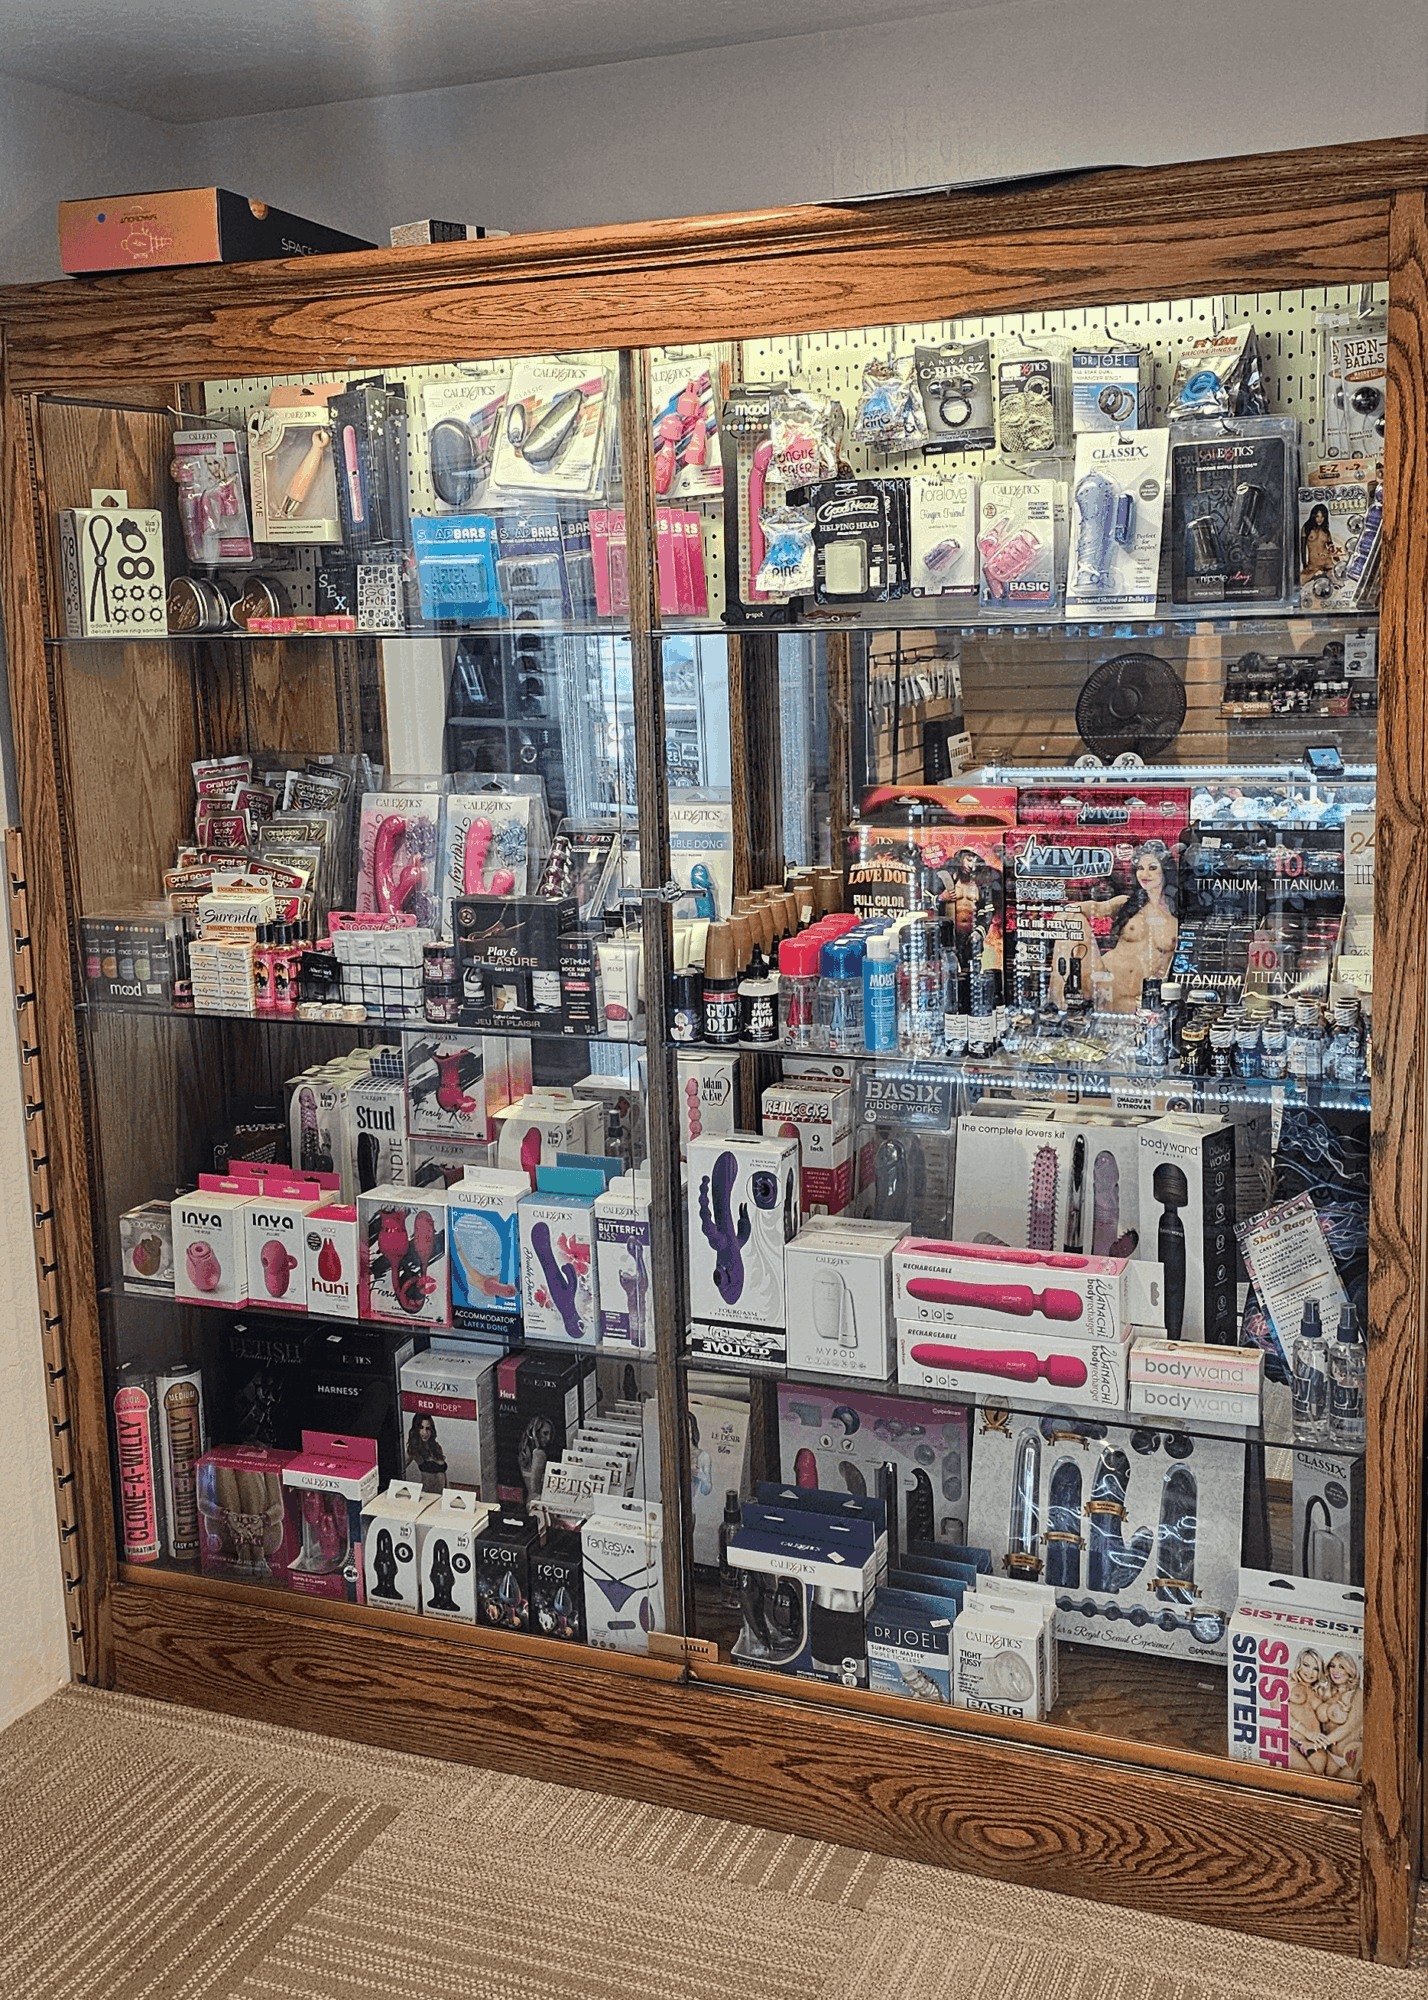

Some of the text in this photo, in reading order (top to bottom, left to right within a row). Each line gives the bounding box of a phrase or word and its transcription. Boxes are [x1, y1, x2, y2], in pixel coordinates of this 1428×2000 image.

[1345, 353, 1385, 369] BALLS
[533, 367, 587, 381] CALEXOTICS
[920, 362, 987, 379] C-RINGZ
[735, 403, 769, 417] mood
[1092, 445, 1149, 460] CLASSIX
[925, 487, 968, 501] oralove
[819, 521, 880, 533] HELPING HEAD
[1136, 532, 1156, 541] Perfect
[1200, 573, 1229, 586] nipple
[1009, 582, 1050, 592] BASIC
[376, 798, 422, 811] CALEXOTICS
[1086, 808, 1129, 819] VIVID
[694, 840, 723, 850] DONG
[1032, 847, 1111, 865] VIVID
[848, 869, 882, 885] LOVE
[1073, 863, 1111, 877] RAW
[1016, 880, 1065, 890] STANDING
[1194, 878, 1258, 890] TITANIUM
[1271, 878, 1336, 891] TITANIUM
[853, 894, 905, 908] FULL COLOR
[202, 905, 258, 924] Surenda
[1017, 916, 1029, 928] LET
[487, 946, 519, 958] Play &
[473, 955, 539, 967] PLEASURE
[559, 957, 591, 966] OPTIMUM
[1172, 953, 1199, 974] 5K
[869, 973, 895, 987] MOIST
[1171, 972, 1242, 987] TITANIUM
[110, 982, 142, 997] mood
[705, 1003, 738, 1018] GUN
[751, 1009, 774, 1017] SAUCE
[753, 1002, 771, 1010] FUCK
[475, 1018, 492, 1026] JEU
[506, 1019, 541, 1028] PLAISIR
[706, 1018, 738, 1033] OIL
[701, 1076, 722, 1091] Adam
[701, 1091, 722, 1102] & Eve
[865, 1080, 943, 1103] BASIX
[765, 1100, 829, 1120] REALCOCKS
[864, 1100, 941, 1115] rubber works
[356, 1105, 396, 1131] Stud
[961, 1122, 1066, 1140] the complete lovers kit
[811, 1134, 821, 1146] 9
[458, 1193, 504, 1207] CALEXOTICS
[598, 1223, 646, 1236] BUTTERFLY
[598, 1232, 617, 1242] KISS
[1252, 1229, 1281, 1246] Shag
[902, 1262, 953, 1275] RECHARGEABLE
[312, 1277, 350, 1296] huni
[454, 1309, 515, 1324] ACCOMMODATOR
[463, 1320, 508, 1333] LATEX DONG
[907, 1328, 957, 1340] RECHARGEABLE
[1144, 1357, 1244, 1383] bodywand
[168, 1390, 195, 1402] MEDIUM
[317, 1384, 360, 1397] HARNESS
[499, 1389, 516, 1401] Hers
[418, 1399, 459, 1413] RED RIDER
[1144, 1389, 1243, 1414] bodywand
[1296, 1452, 1347, 1479] CLASSIX
[118, 1420, 150, 1543] CLONE-A-WILLY
[170, 1416, 199, 1538] CLONE-A-WILLY
[546, 1475, 605, 1495] FETISH
[586, 1535, 628, 1556] fantasy
[896, 1628, 941, 1650] JOEL
[965, 1630, 1023, 1650] CALEXOTICS
[1074, 1625, 1101, 1640] Regal
[1101, 1630, 1131, 1644] Sexual
[1131, 1635, 1175, 1650] Experience!
[871, 1643, 924, 1660] SUPPORT MASTER
[871, 1650, 921, 1665] TRIPLE TICKLERS
[960, 1649, 983, 1661] TIGHT
[960, 1656, 983, 1668] PUSSY
[1232, 1633, 1257, 1745] SISTER
[967, 1698, 1023, 1719] BASIC
